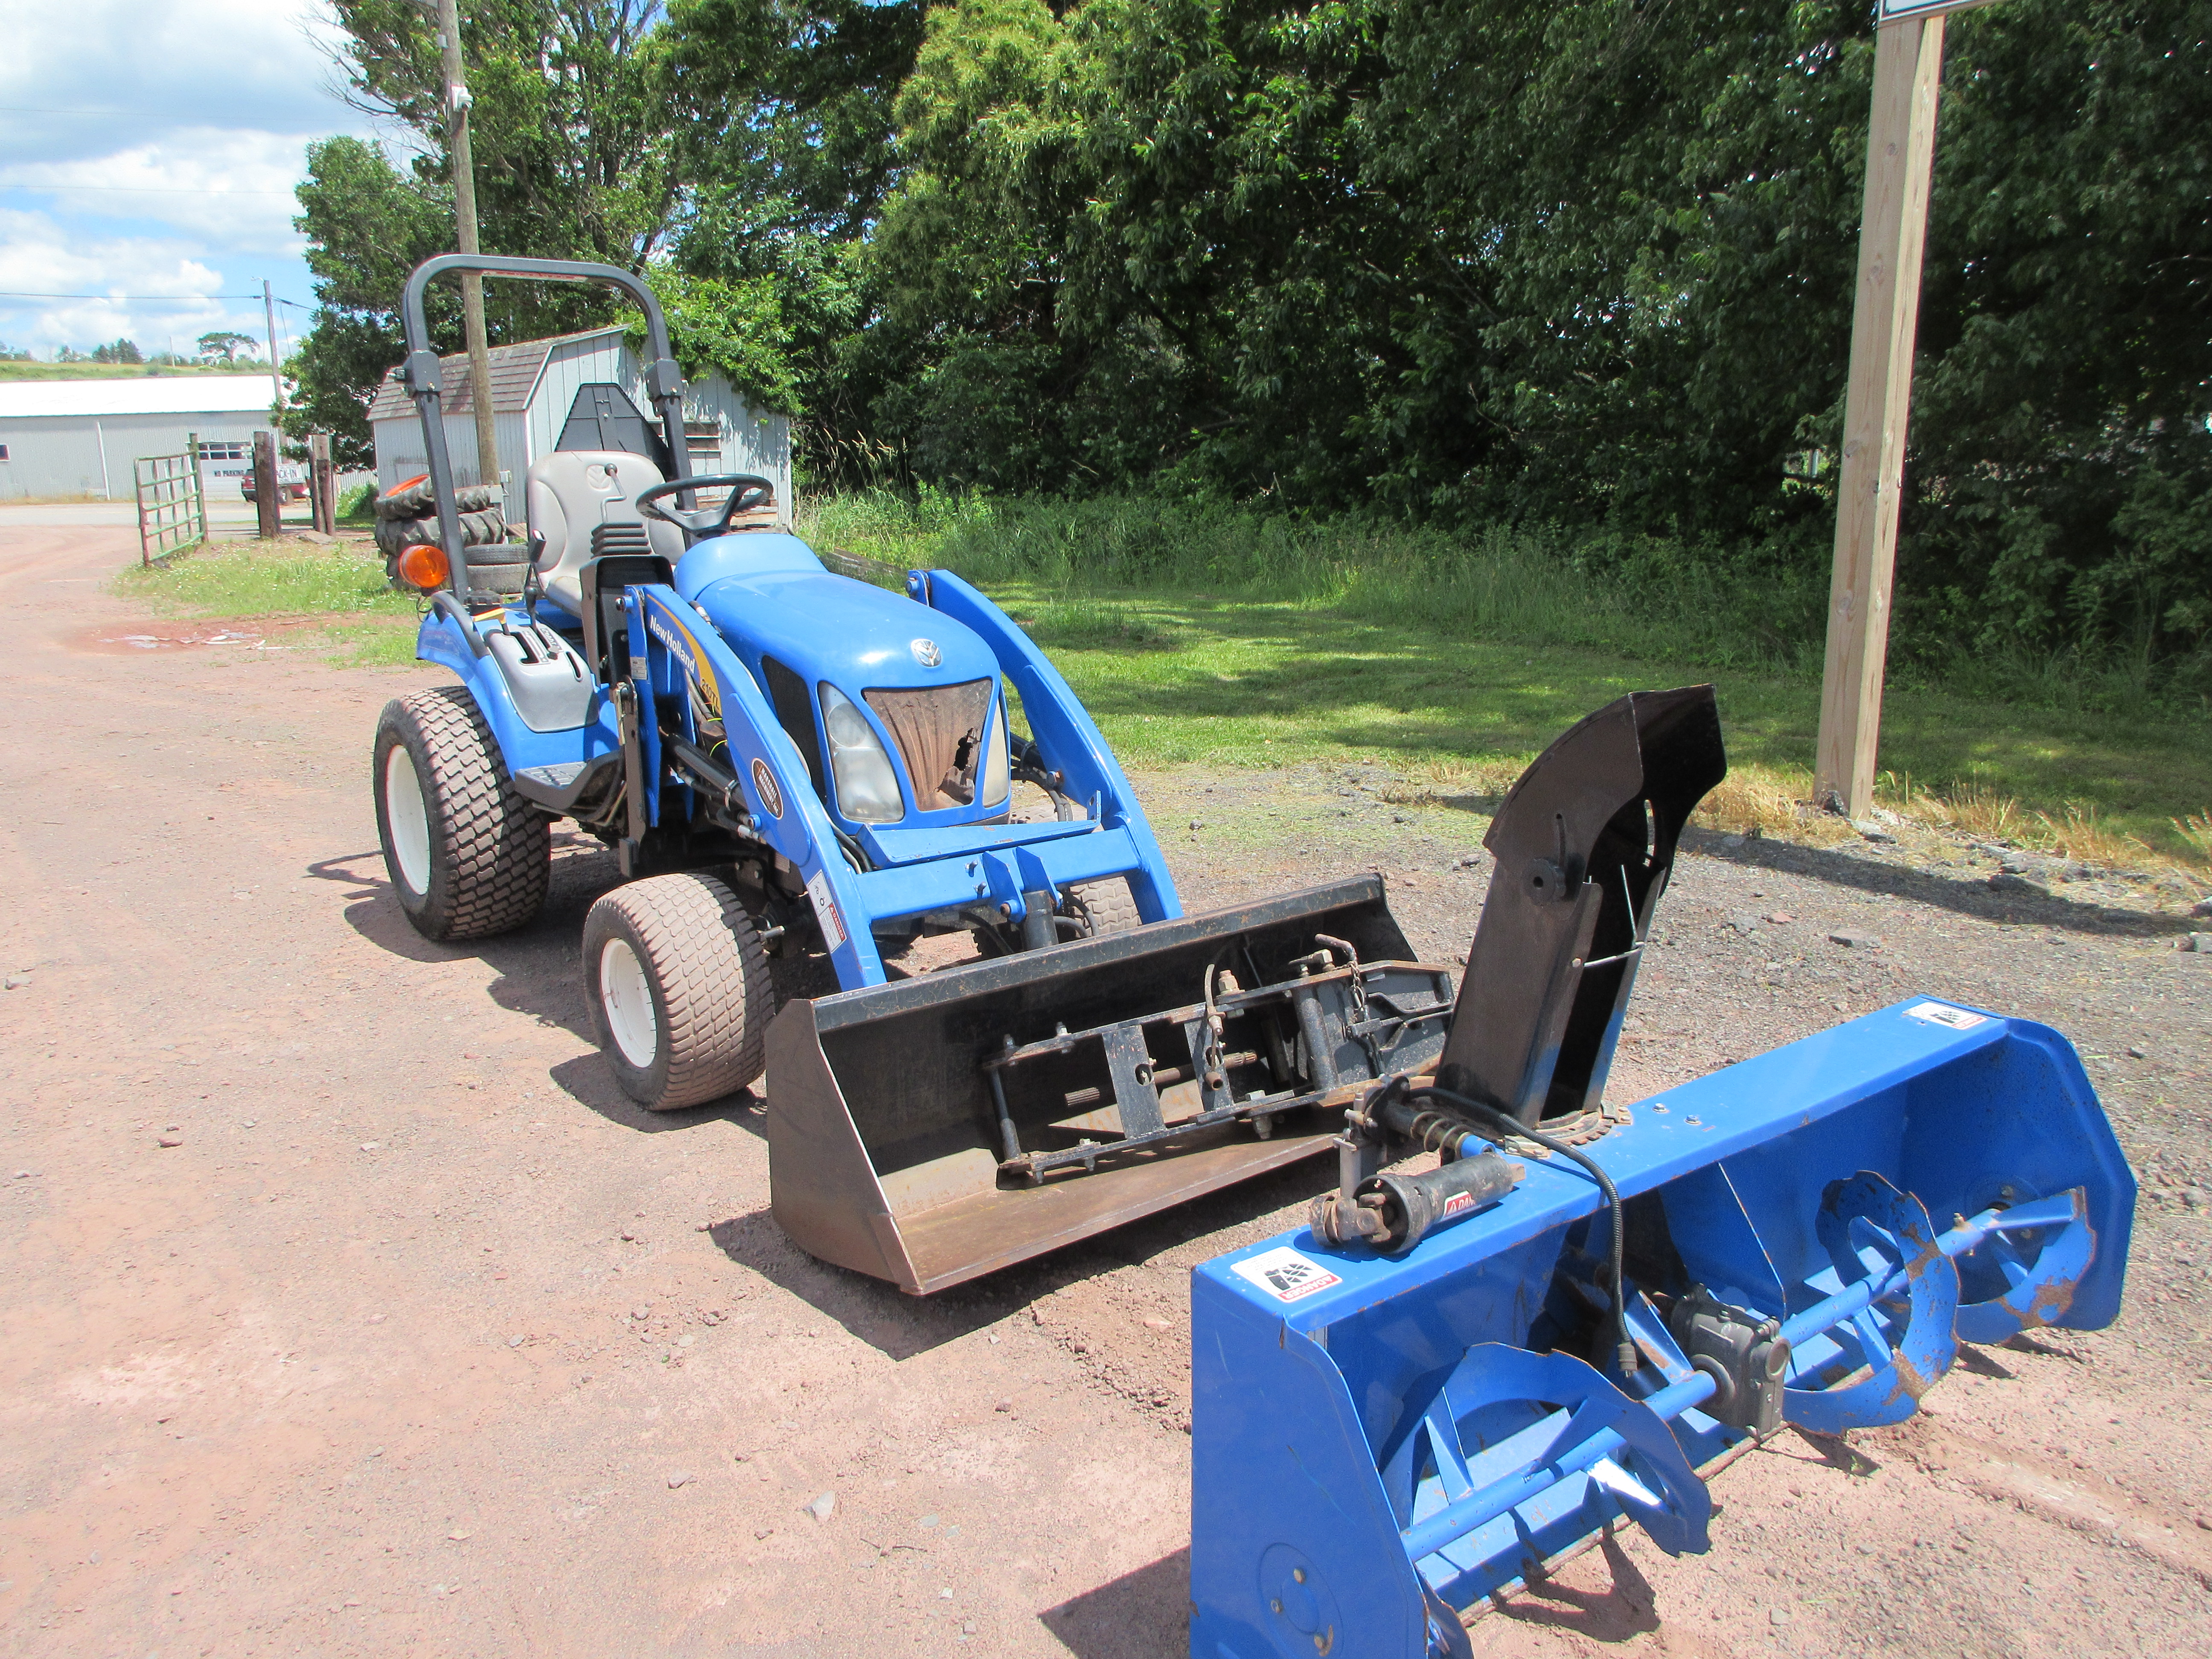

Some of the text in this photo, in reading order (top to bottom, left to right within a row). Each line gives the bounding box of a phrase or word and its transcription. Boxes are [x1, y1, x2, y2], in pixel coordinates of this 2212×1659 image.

[832, 913, 844, 938] DANGER
[1458, 1196, 1476, 1211] DAN
[1282, 1278, 1327, 1299] DANGER
